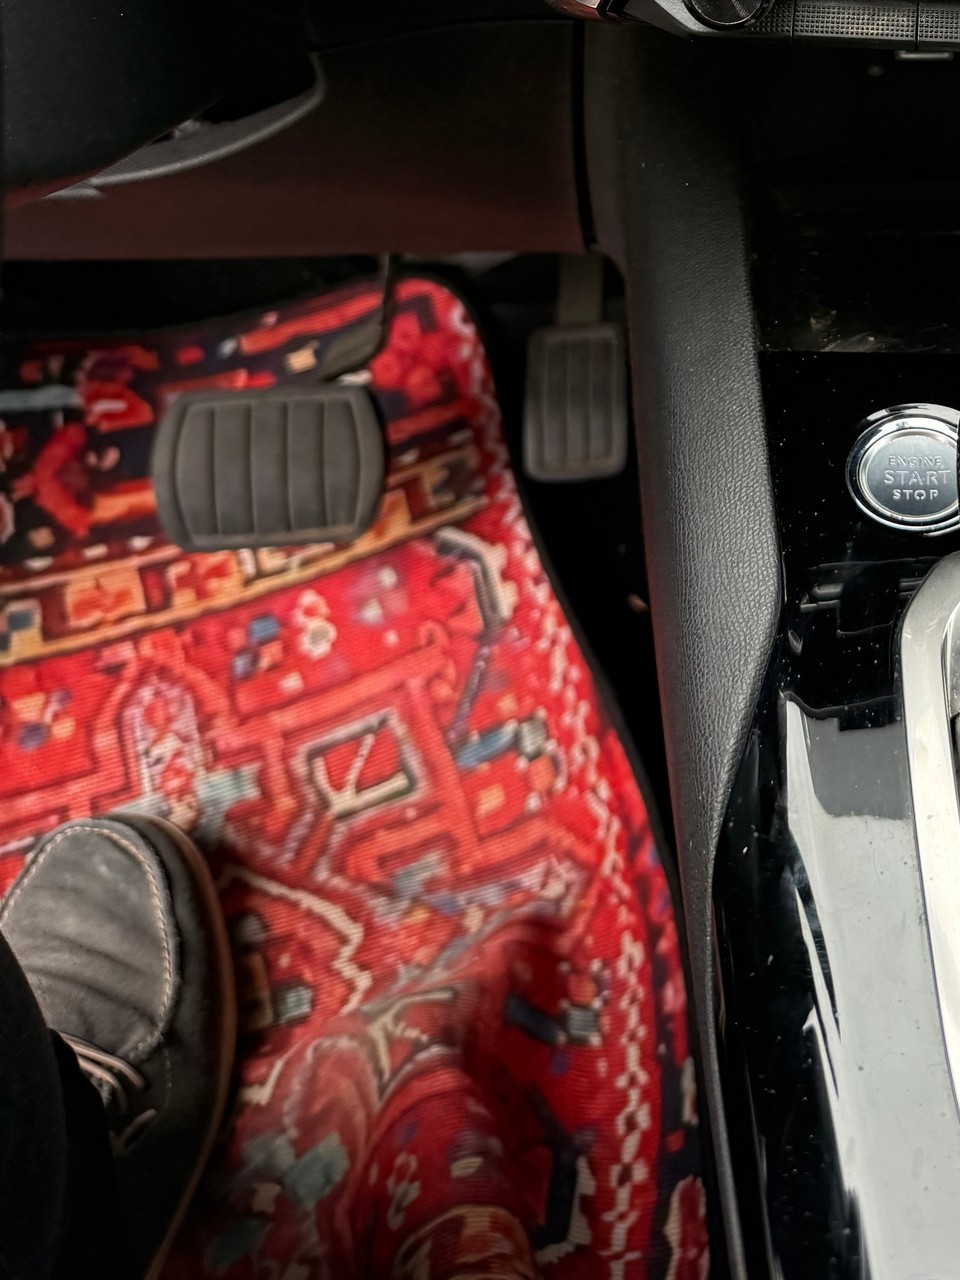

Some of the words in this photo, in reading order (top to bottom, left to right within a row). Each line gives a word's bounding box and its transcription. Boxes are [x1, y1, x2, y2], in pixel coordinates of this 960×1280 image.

[888, 455, 942, 468] ENGINE
[883, 469, 951, 486] START
[892, 489, 939, 500] STOP
